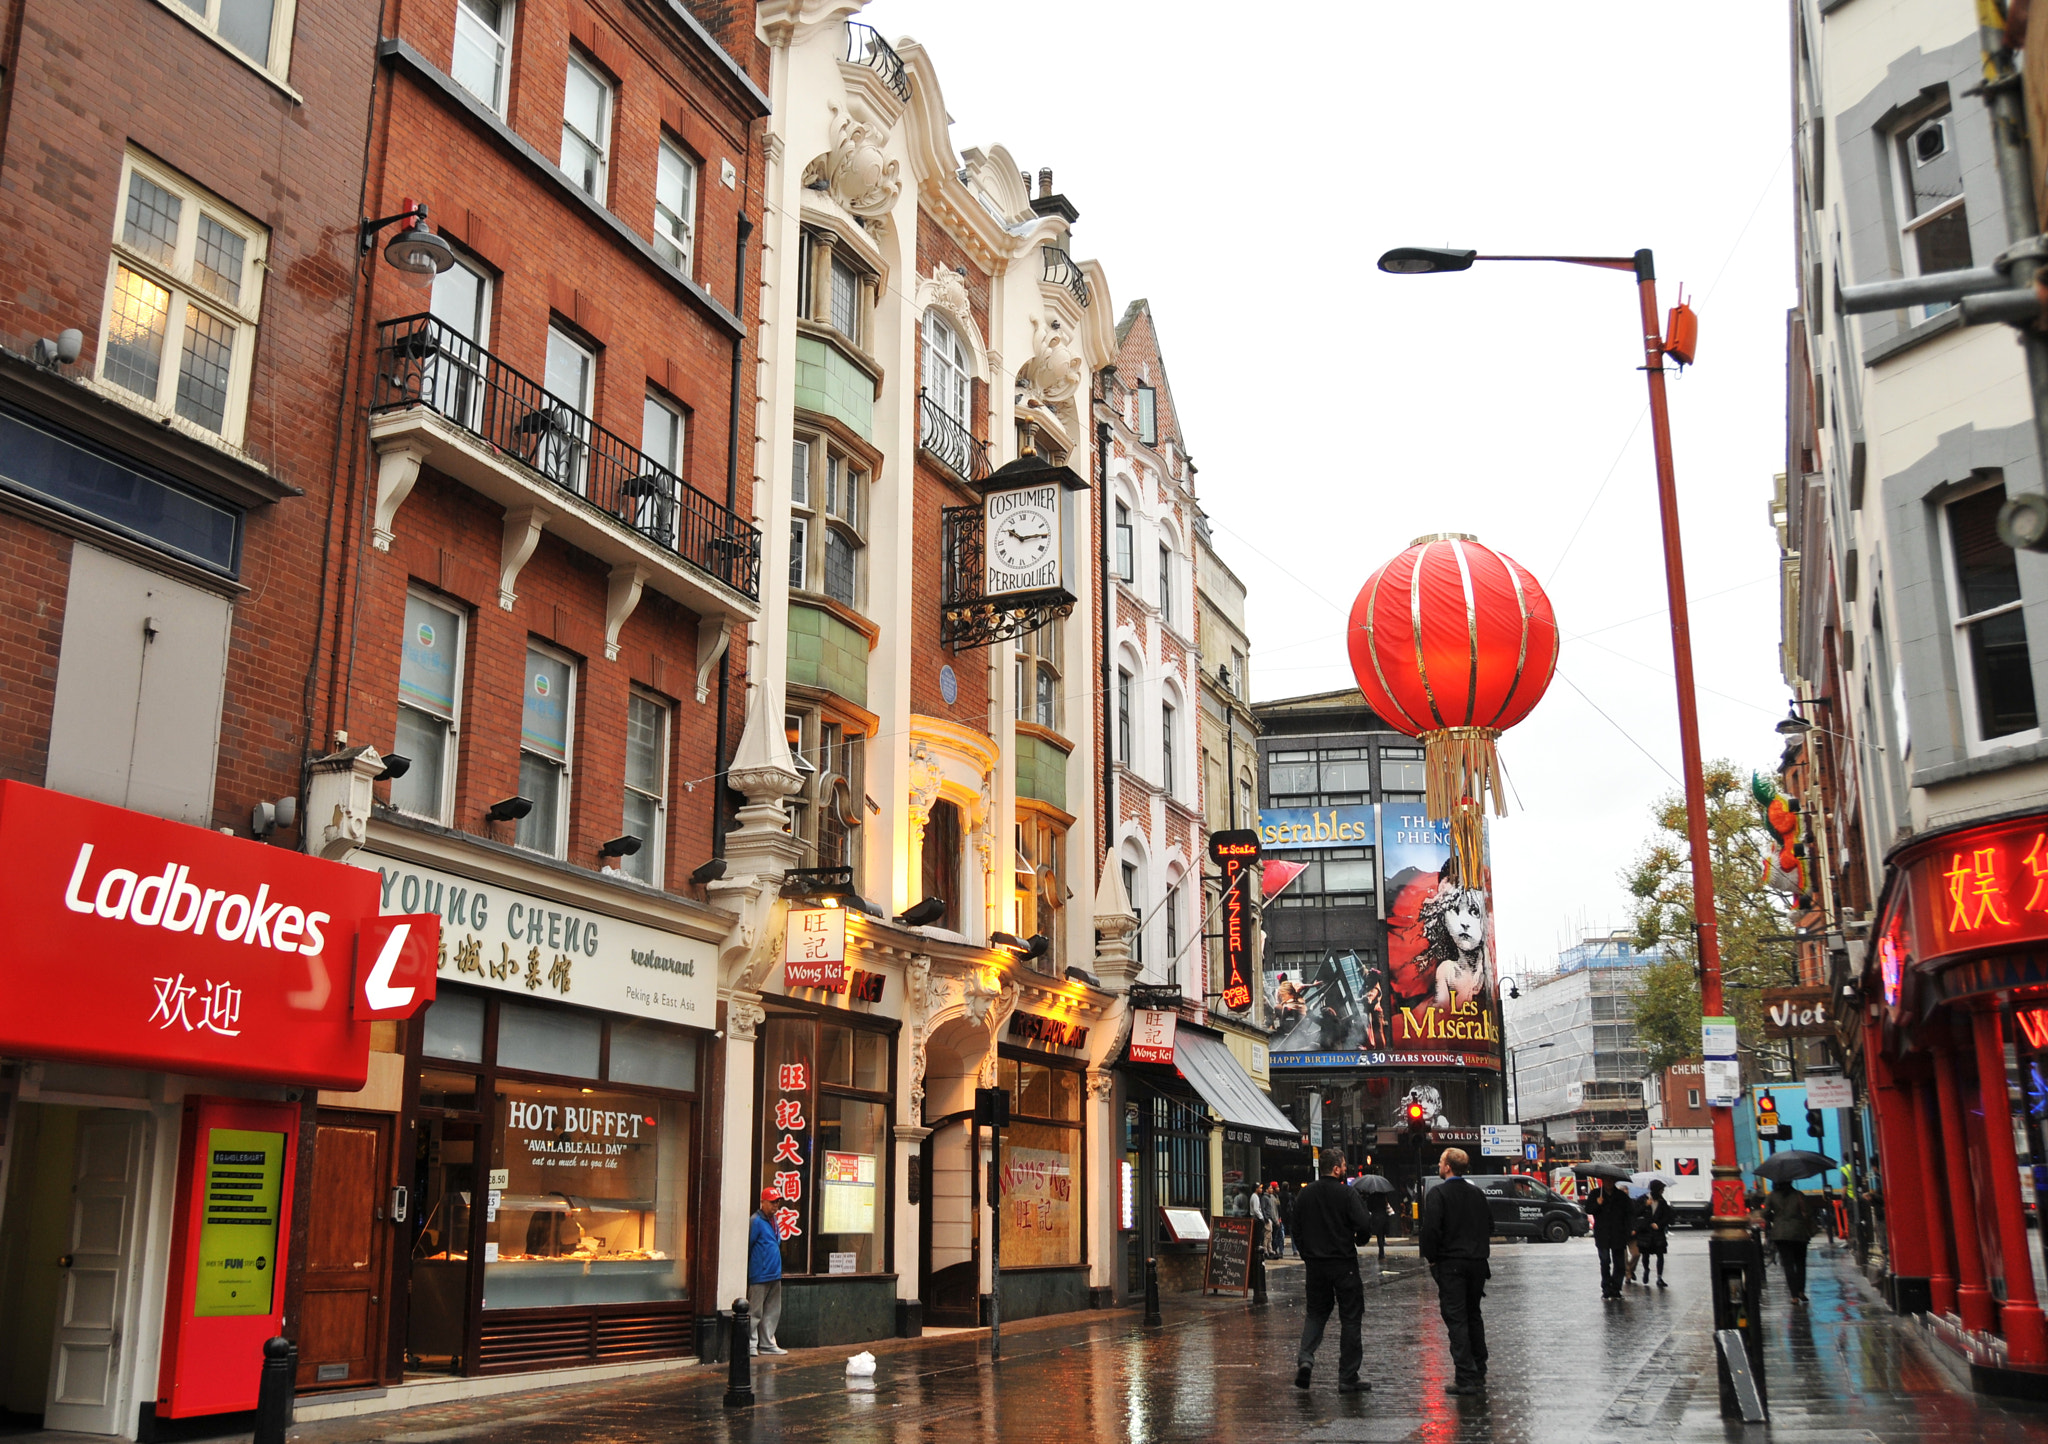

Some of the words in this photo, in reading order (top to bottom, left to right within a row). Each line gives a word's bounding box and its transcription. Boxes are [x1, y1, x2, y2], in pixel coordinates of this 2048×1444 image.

[989, 487, 1055, 519] COSTUMIER
[989, 560, 1056, 592] PERRUQUIER
[64, 842, 331, 957] Ladbrokes
[378, 866, 488, 931] YOUNG
[507, 902, 599, 957] CHENG
[803, 912, 830, 960] 旺記
[1227, 860, 1243, 986] PIZZERIA
[364, 923, 416, 1011] L
[631, 947, 695, 978] restaurant
[787, 964, 822, 983] Wong
[824, 963, 842, 979] Kei
[148, 972, 243, 1037] 欢迎
[626, 986, 651, 1005] Peking
[653, 993, 659, 1005] &
[661, 994, 678, 1008] East
[680, 998, 695, 1012] Asia
[1222, 985, 1248, 999] OPEN
[1228, 994, 1251, 1008] LATE
[1449, 990, 1478, 1016] Les
[1399, 1006, 1500, 1044] Misérables
[1769, 999, 1826, 1027] Viet
[1131, 1046, 1158, 1061] Wong
[1158, 1048, 1172, 1061] Kei
[1270, 1056, 1302, 1065] HAPPY
[1305, 1055, 1357, 1064] BIRTHDAY
[1371, 1053, 1386, 1063] 30
[1388, 1053, 1419, 1063] YEARS
[1421, 1053, 1455, 1064] YOUNG
[1465, 1056, 1489, 1065] HAPPY
[509, 1101, 558, 1131] HOT
[564, 1106, 643, 1139] BUFFET
[584, 1142, 603, 1155] ALL
[1438, 1132, 1479, 1140] WORLD'S
[532, 1157, 545, 1166] eat
[547, 1159, 556, 1167] as
[558, 1157, 577, 1167] much
[590, 1160, 602, 1170] you
[605, 1158, 618, 1169] like
[773, 1063, 806, 1241] 旺記大酒家
[999, 1156, 1045, 1196] Wong
[1049, 1159, 1071, 1202] Kei
[224, 1258, 244, 1269] FUN
